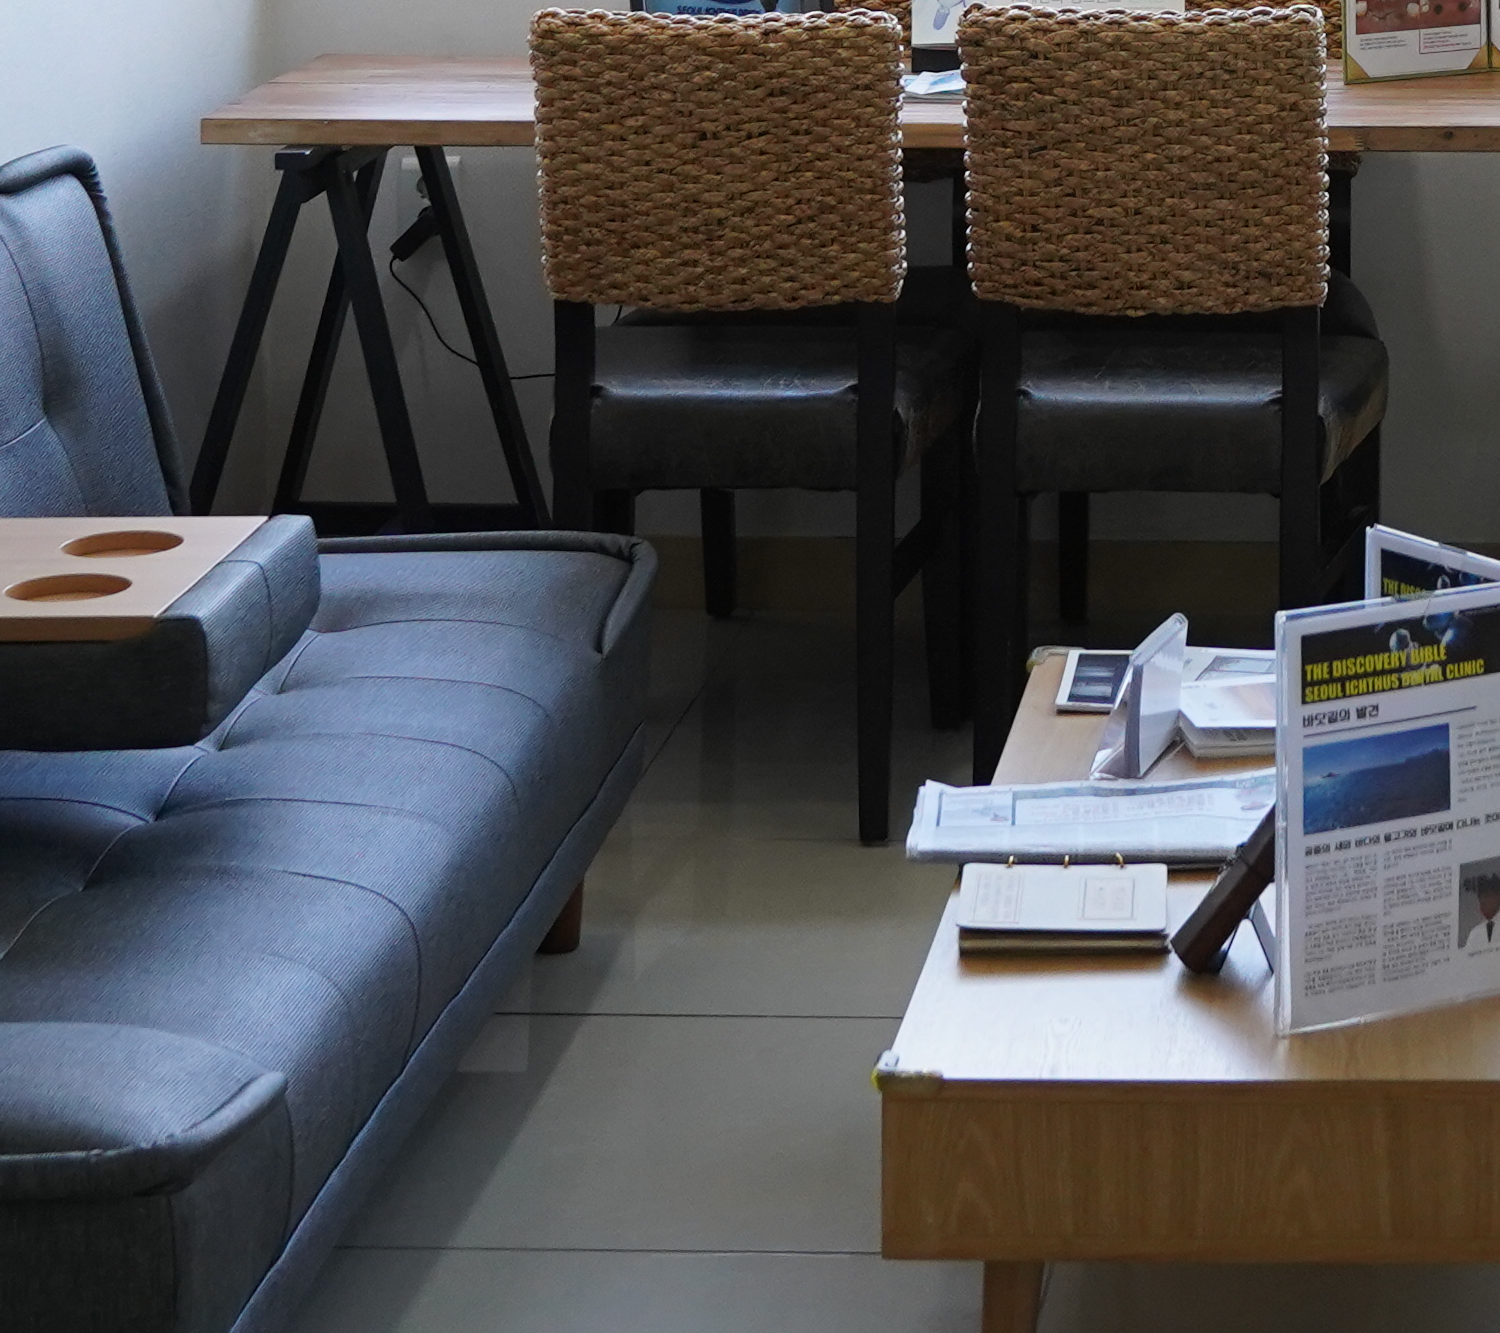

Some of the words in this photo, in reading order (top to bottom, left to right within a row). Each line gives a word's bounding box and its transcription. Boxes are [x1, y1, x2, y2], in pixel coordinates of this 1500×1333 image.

[1305, 661, 1331, 683] THE
[1332, 650, 1407, 677] DISCOVERY
[1411, 643, 1448, 665] BIBLE
[1305, 683, 1344, 703] SEOUL
[1346, 675, 1400, 696] ICHTHUS
[1446, 657, 1485, 681] CLINIC
[1355, 703, 1380, 720] 발견
